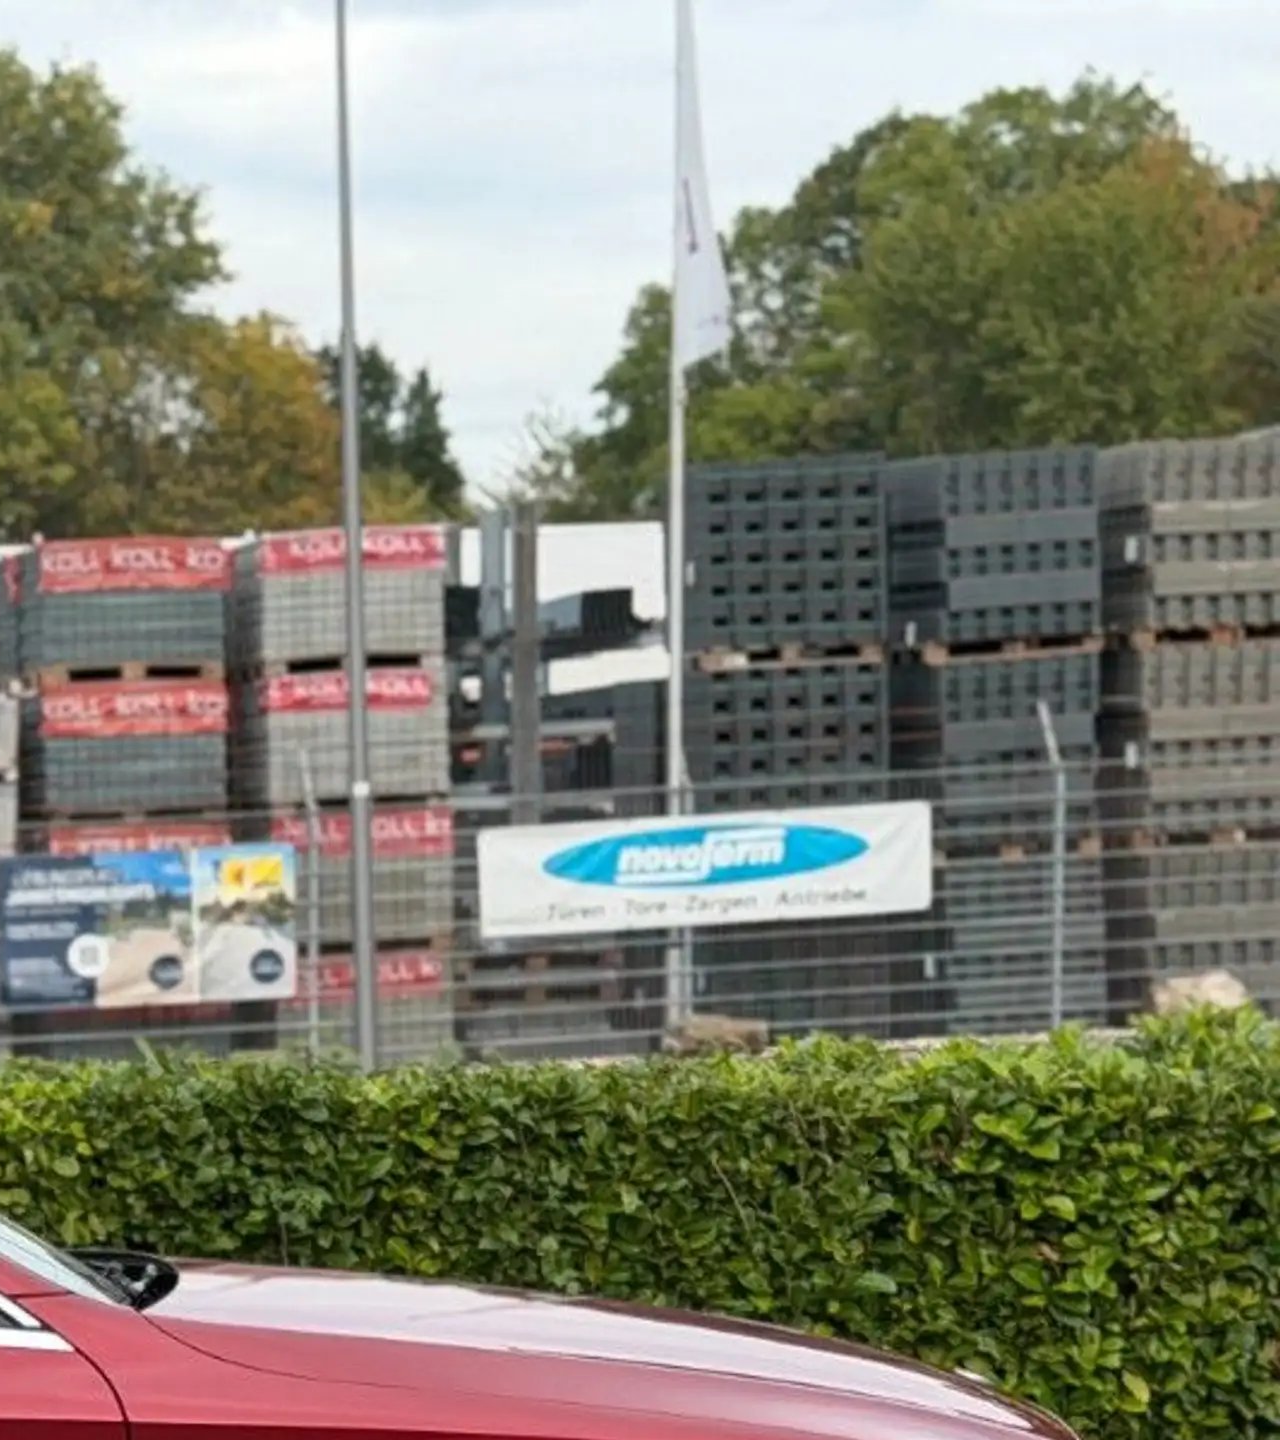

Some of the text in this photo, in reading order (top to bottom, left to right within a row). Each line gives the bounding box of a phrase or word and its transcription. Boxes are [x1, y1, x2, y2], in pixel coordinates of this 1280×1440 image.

[42, 549, 100, 573] KOLL
[111, 544, 175, 571] KOLL
[371, 815, 420, 840] OLL
